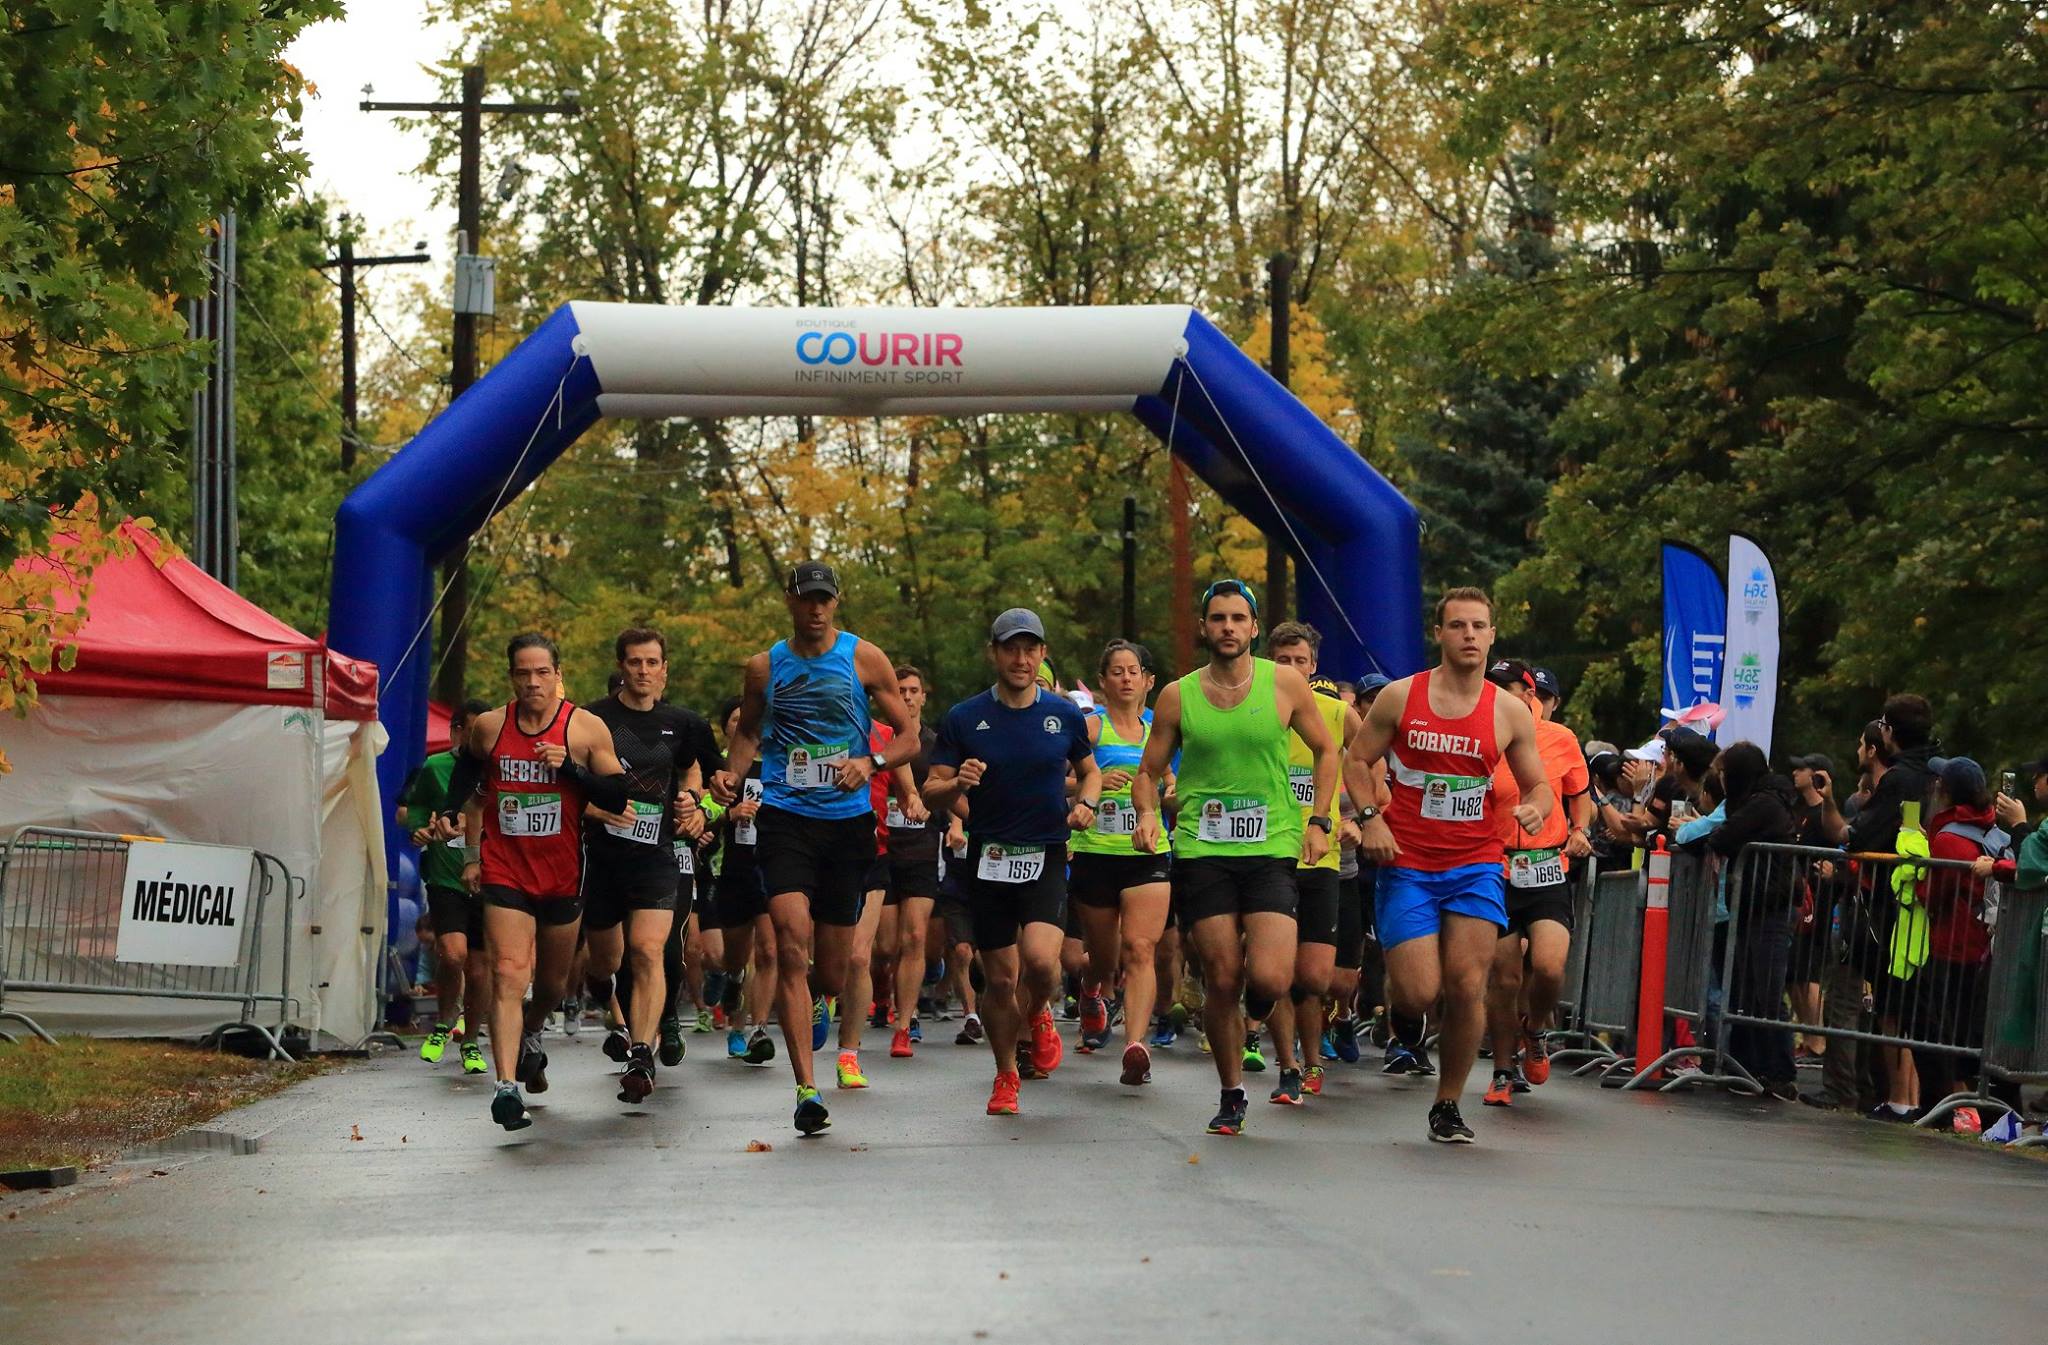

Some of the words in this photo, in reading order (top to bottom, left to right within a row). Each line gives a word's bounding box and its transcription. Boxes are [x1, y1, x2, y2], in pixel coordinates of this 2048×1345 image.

[796, 320, 856, 328] BOUTIQUE
[796, 331, 963, 366] COURIR
[795, 370, 898, 384] INFINIMENT
[904, 370, 964, 384] SPORT
[1407, 729, 1484, 759] CORNELL
[1451, 796, 1481, 817] 1482
[526, 812, 557, 832] 1577
[632, 820, 659, 840] 1691
[1230, 816, 1263, 838] 1607
[677, 854, 691, 871] 92
[1008, 860, 1040, 880] 1557
[1534, 865, 1562, 884] 1695
[132, 871, 235, 927] MÉDICAL
